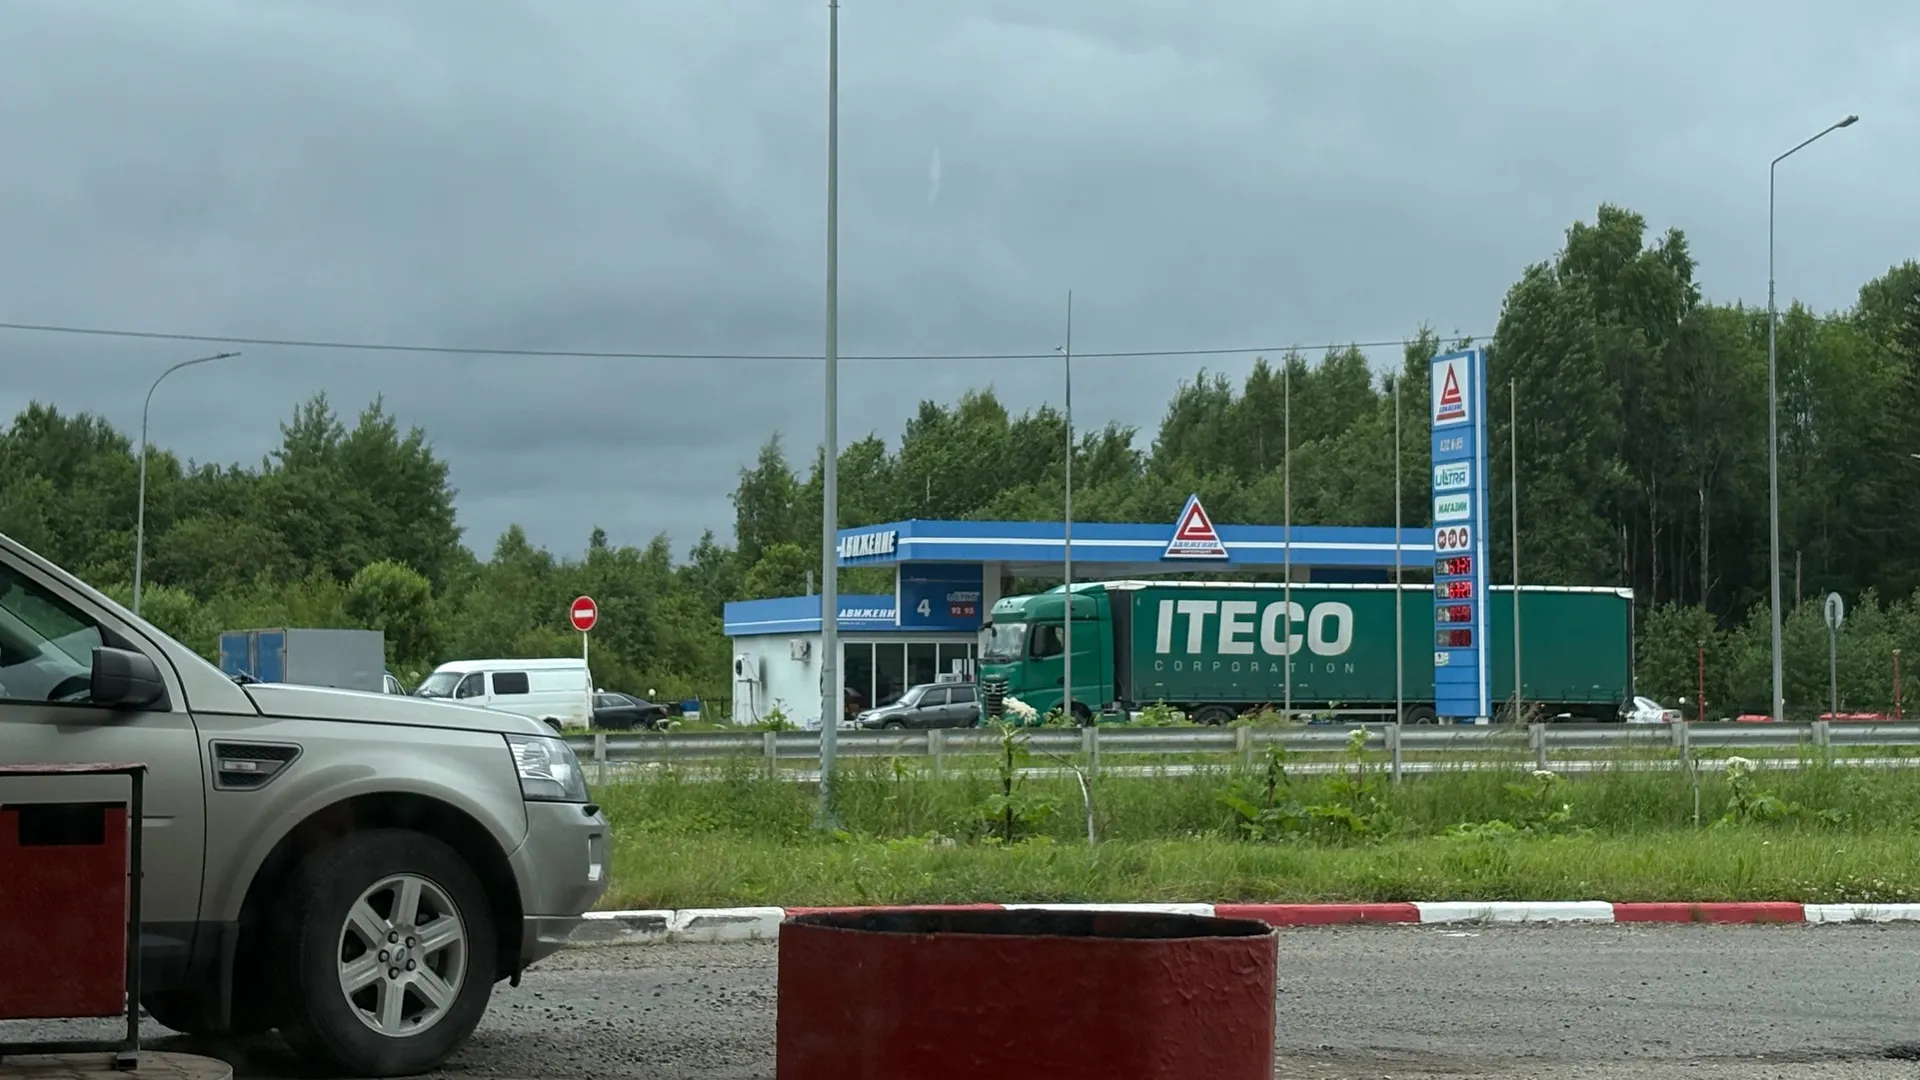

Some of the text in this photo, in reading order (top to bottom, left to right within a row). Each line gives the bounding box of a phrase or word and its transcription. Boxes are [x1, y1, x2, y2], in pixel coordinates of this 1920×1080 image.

[1435, 469, 1466, 487] ULTRA
[1438, 502, 1467, 513] МАГАЗИН
[839, 530, 897, 558] ДВИЖЕНИЕ
[839, 608, 896, 618] ДВИЖЕНИ
[917, 598, 931, 617] 4
[1155, 600, 1354, 656] ITECO
[1154, 660, 1355, 674] CORPORATION
